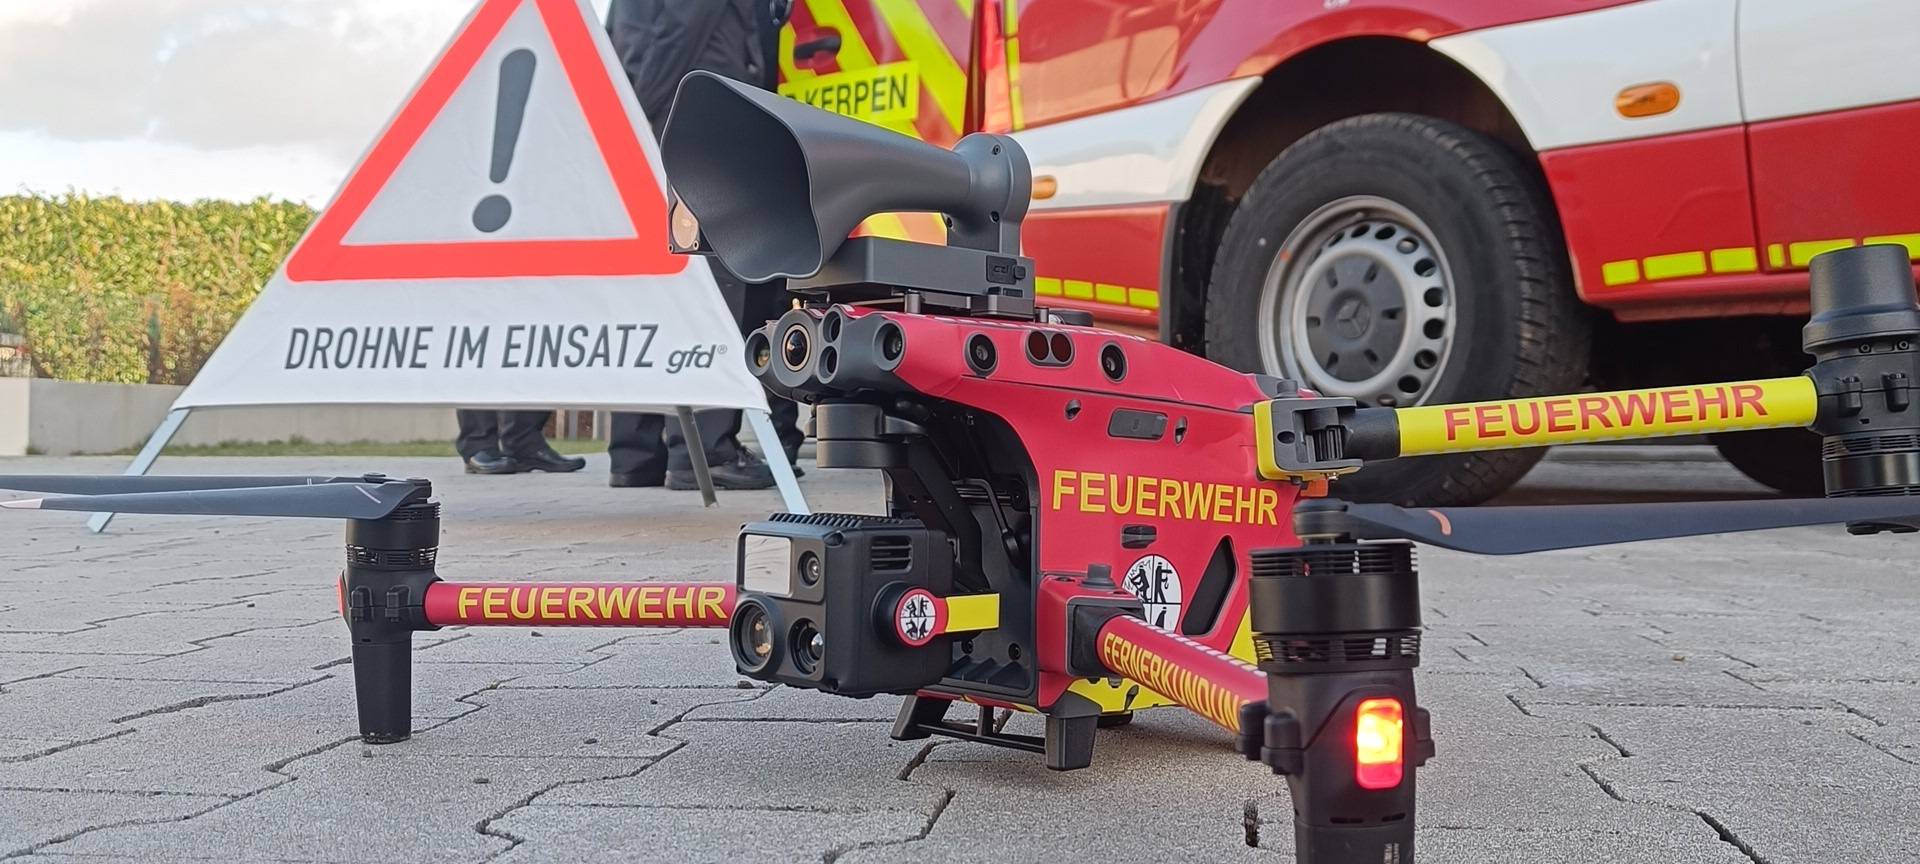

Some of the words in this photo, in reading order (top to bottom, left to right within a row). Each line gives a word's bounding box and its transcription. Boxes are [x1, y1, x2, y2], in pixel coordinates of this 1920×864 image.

[804, 73, 908, 115] KERPEN
[285, 326, 433, 369] DROHNE
[443, 326, 489, 368] IM
[501, 323, 659, 368] EINSATZ
[1444, 384, 1768, 441] FEUERWEHR
[1052, 469, 1279, 526] FEUERWEHR
[458, 587, 728, 619] FEUERWEHR
[1103, 632, 1250, 733] FERNERKUNDUN
